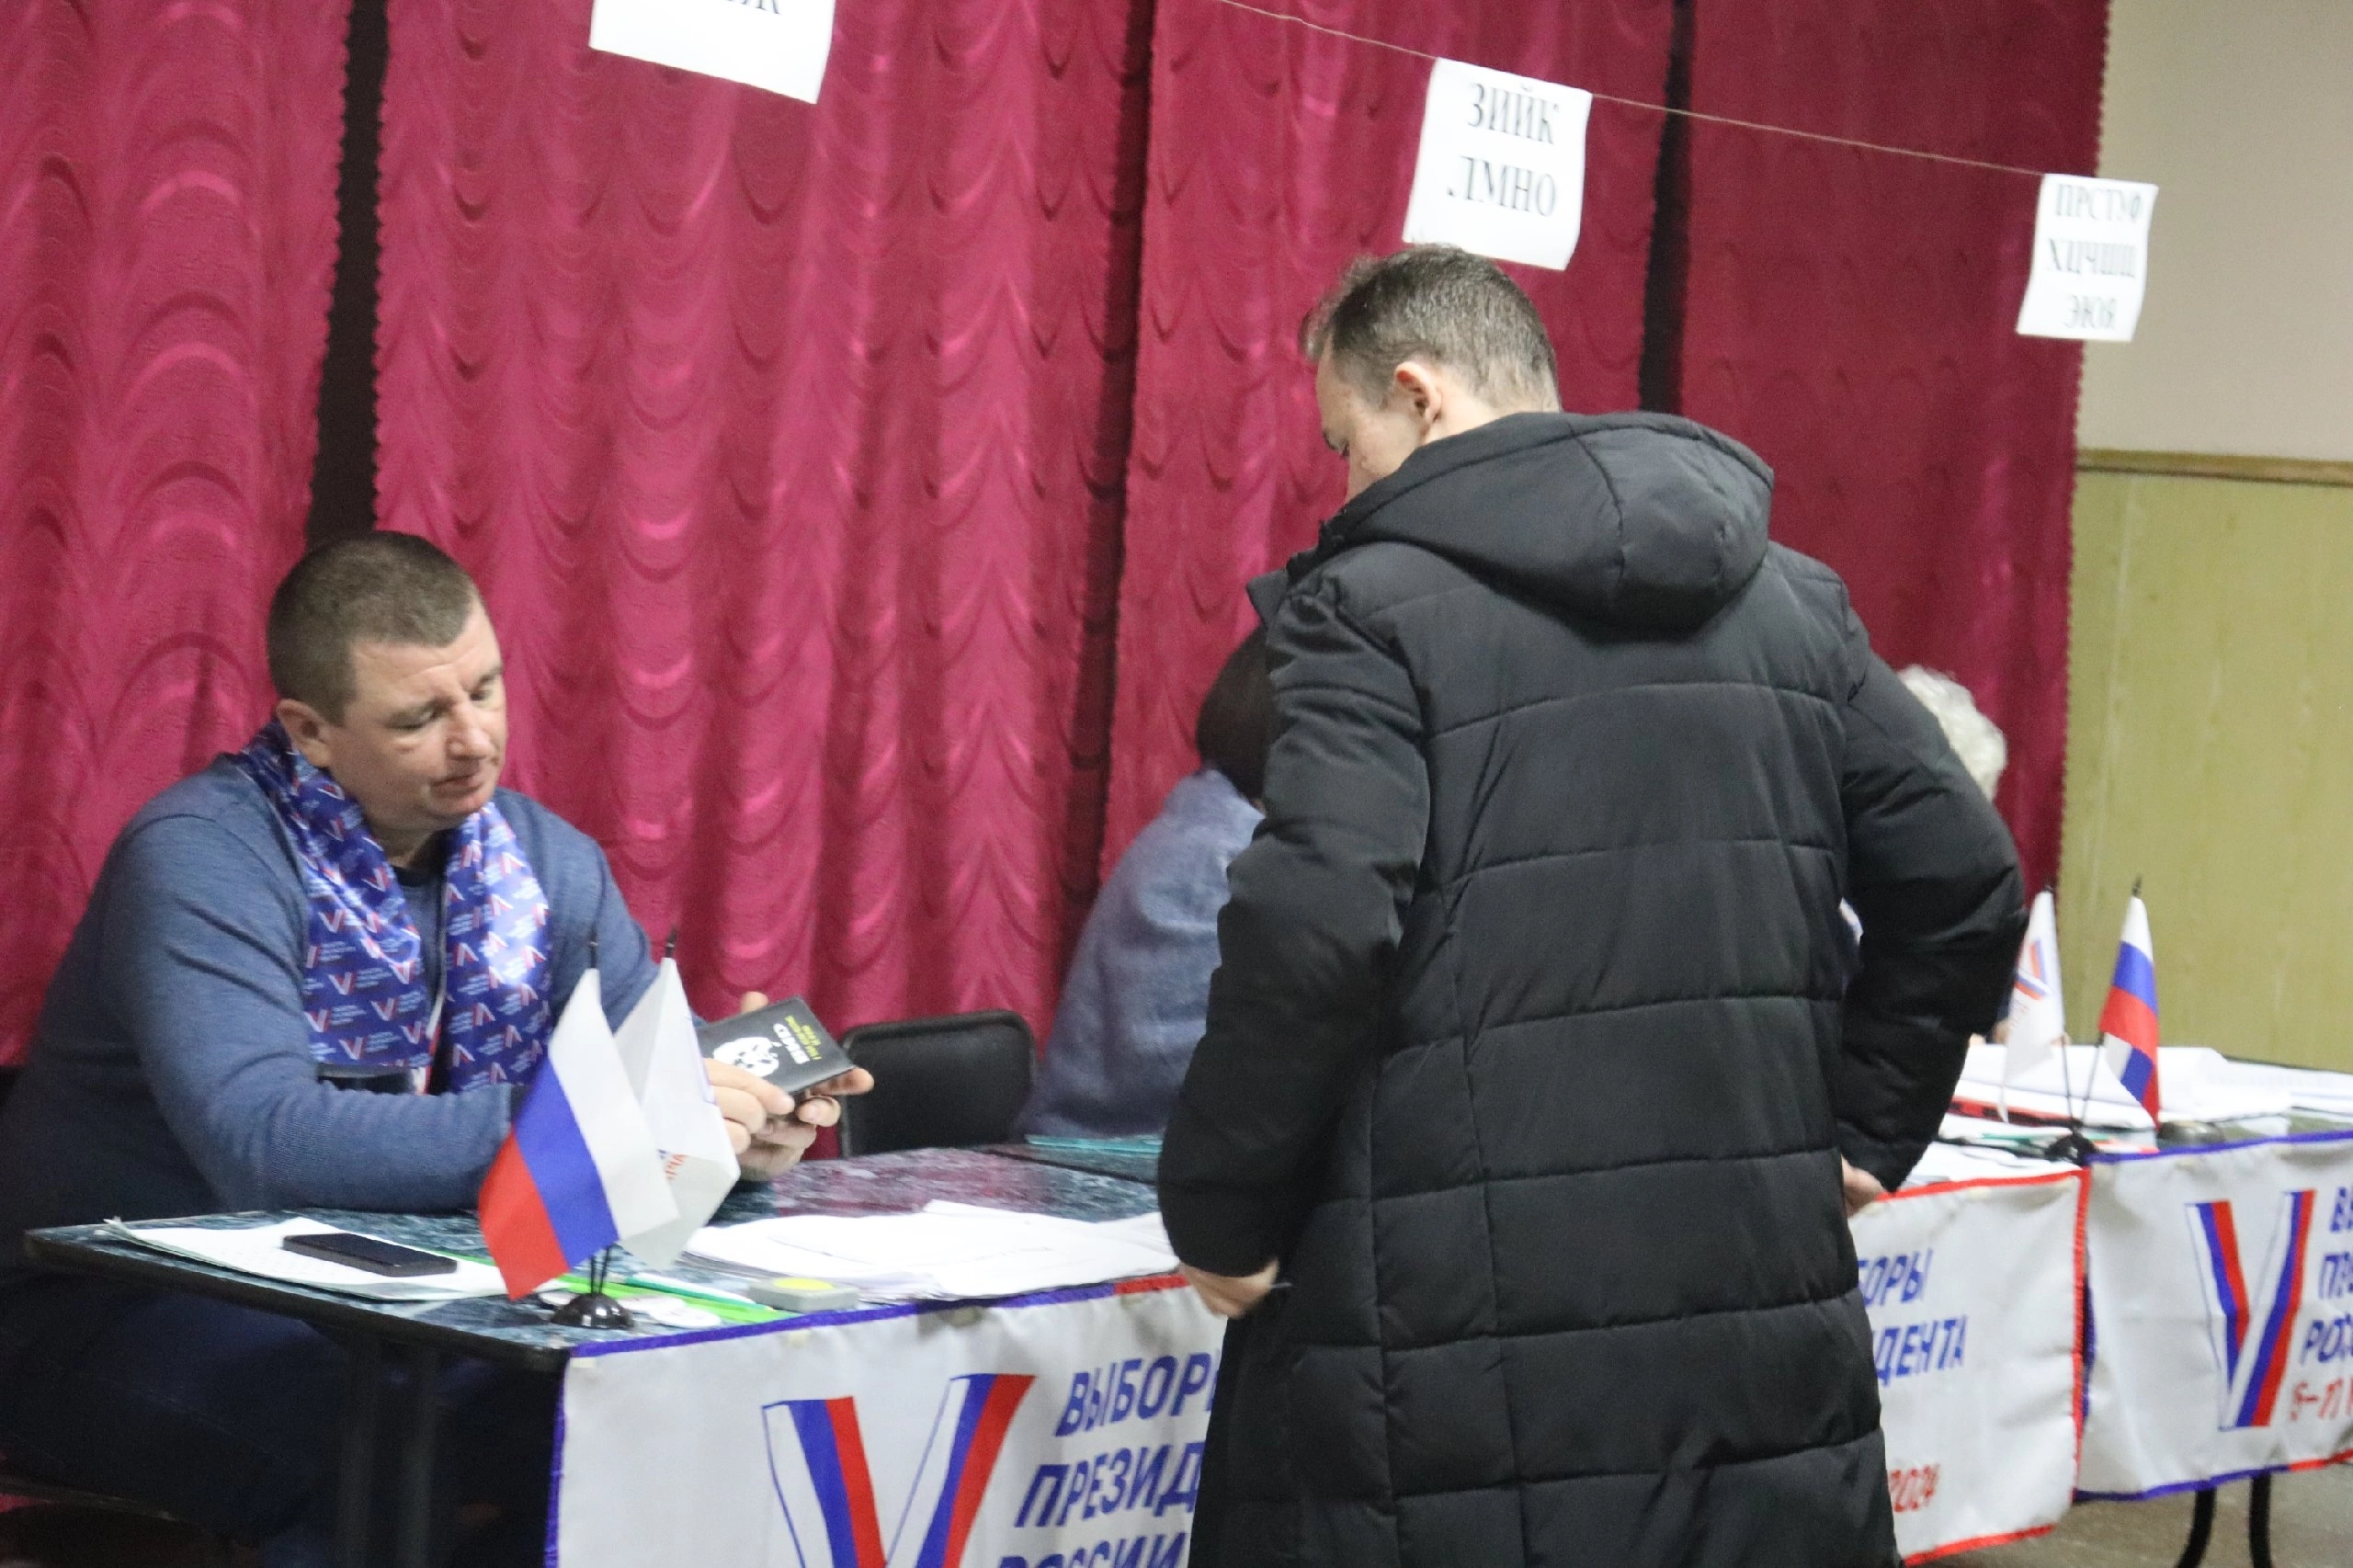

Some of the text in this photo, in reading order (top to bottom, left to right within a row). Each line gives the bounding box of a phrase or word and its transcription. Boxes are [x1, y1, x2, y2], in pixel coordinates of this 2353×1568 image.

[1467, 82, 1560, 144] ЗИЙК
[1446, 154, 1556, 217] ЛМНО
[1054, 1351, 1221, 1437] ВЫБОР
